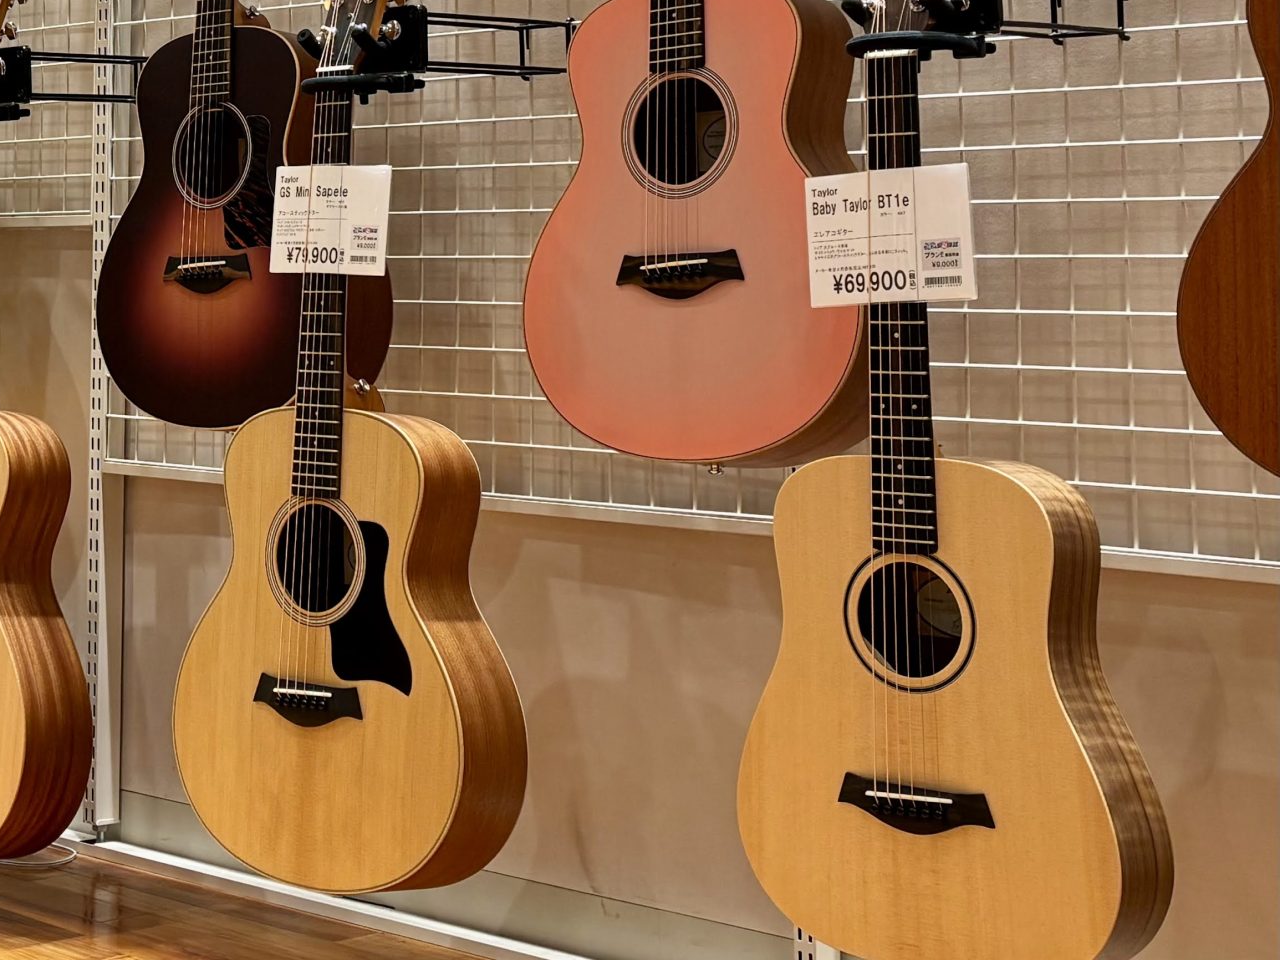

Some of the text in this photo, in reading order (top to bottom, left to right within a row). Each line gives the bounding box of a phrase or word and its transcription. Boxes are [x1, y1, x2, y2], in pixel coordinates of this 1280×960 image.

[280, 185, 348, 198] GS Min Sapele
[811, 188, 838, 198] Taylor
[812, 201, 836, 216] Baby
[878, 194, 910, 209] BT1e
[286, 247, 338, 264] ¥79,900
[833, 270, 907, 294] ¥69,900
